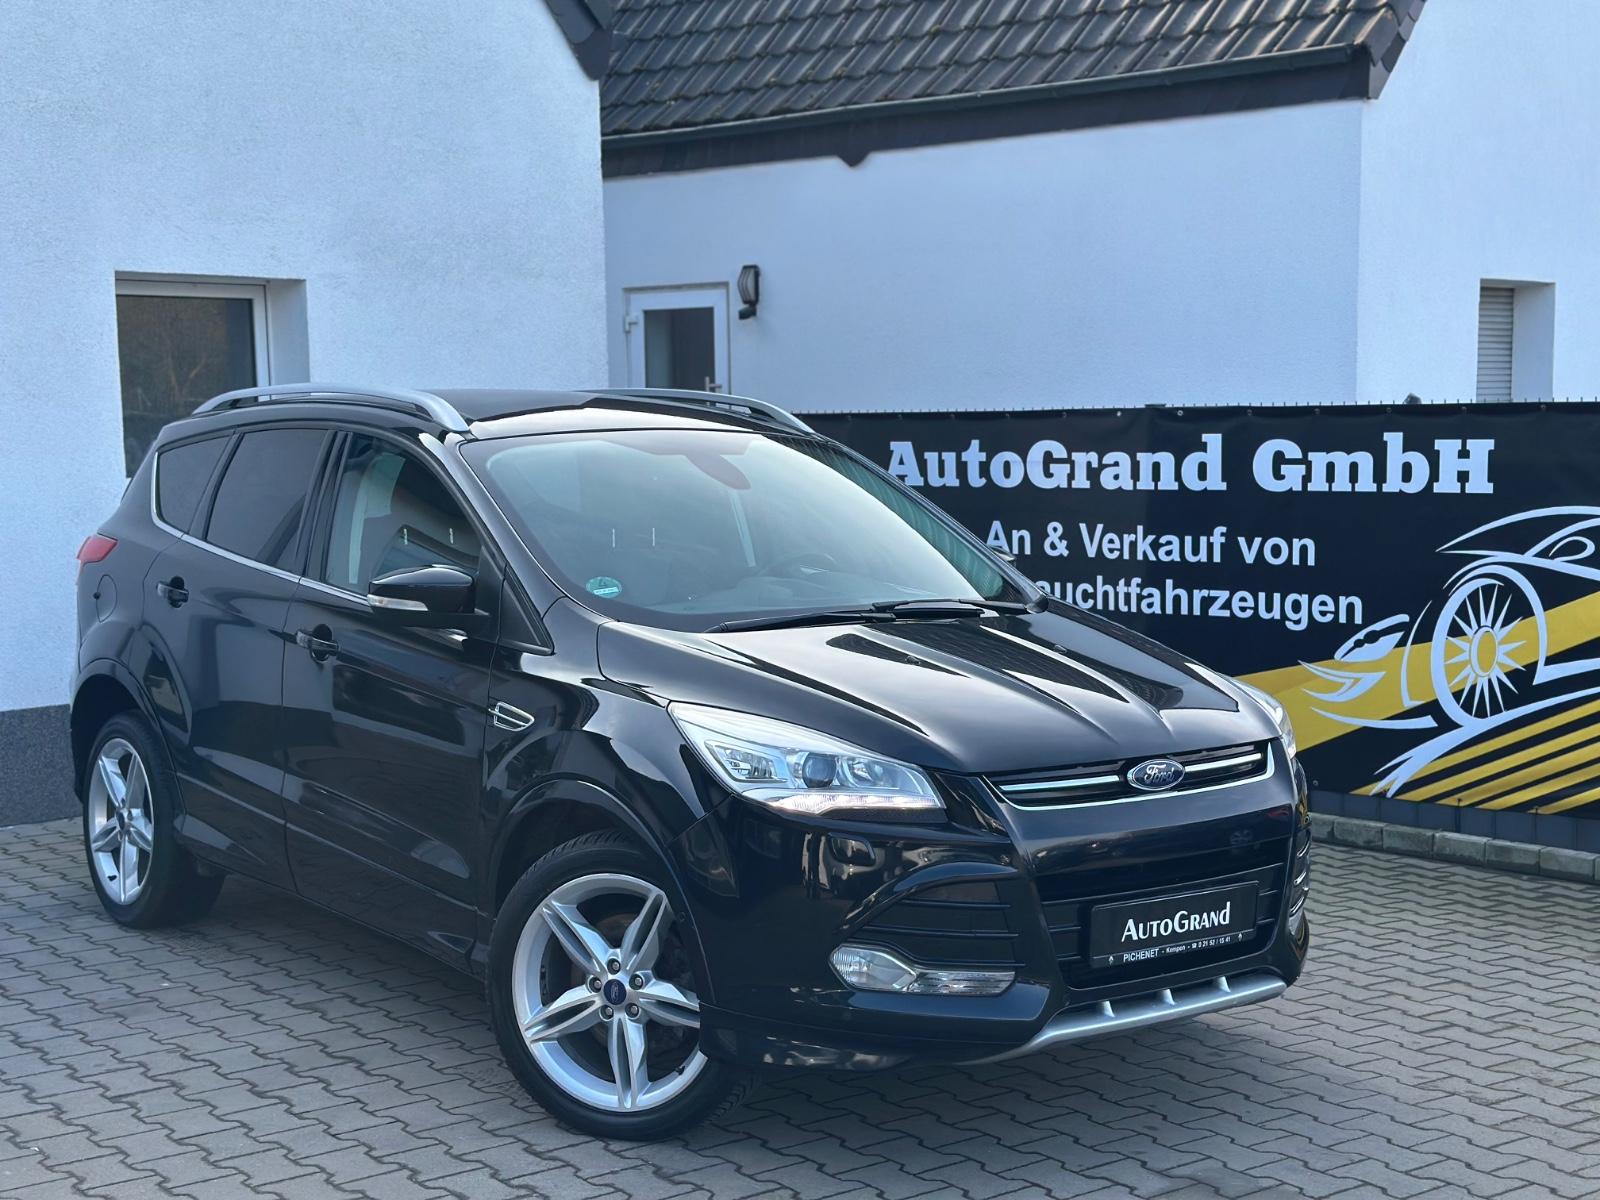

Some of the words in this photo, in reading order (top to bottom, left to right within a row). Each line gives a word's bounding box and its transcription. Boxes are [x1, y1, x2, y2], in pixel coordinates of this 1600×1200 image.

[887, 433, 1227, 492] AutoGrand
[1252, 432, 1496, 494] GmbH
[986, 520, 1031, 555] An
[1043, 521, 1070, 558] &
[1079, 523, 1227, 563] Verkauf
[1238, 536, 1316, 566] von
[1144, 764, 1175, 783] Ford
[1123, 948, 1160, 963] PICHENET
